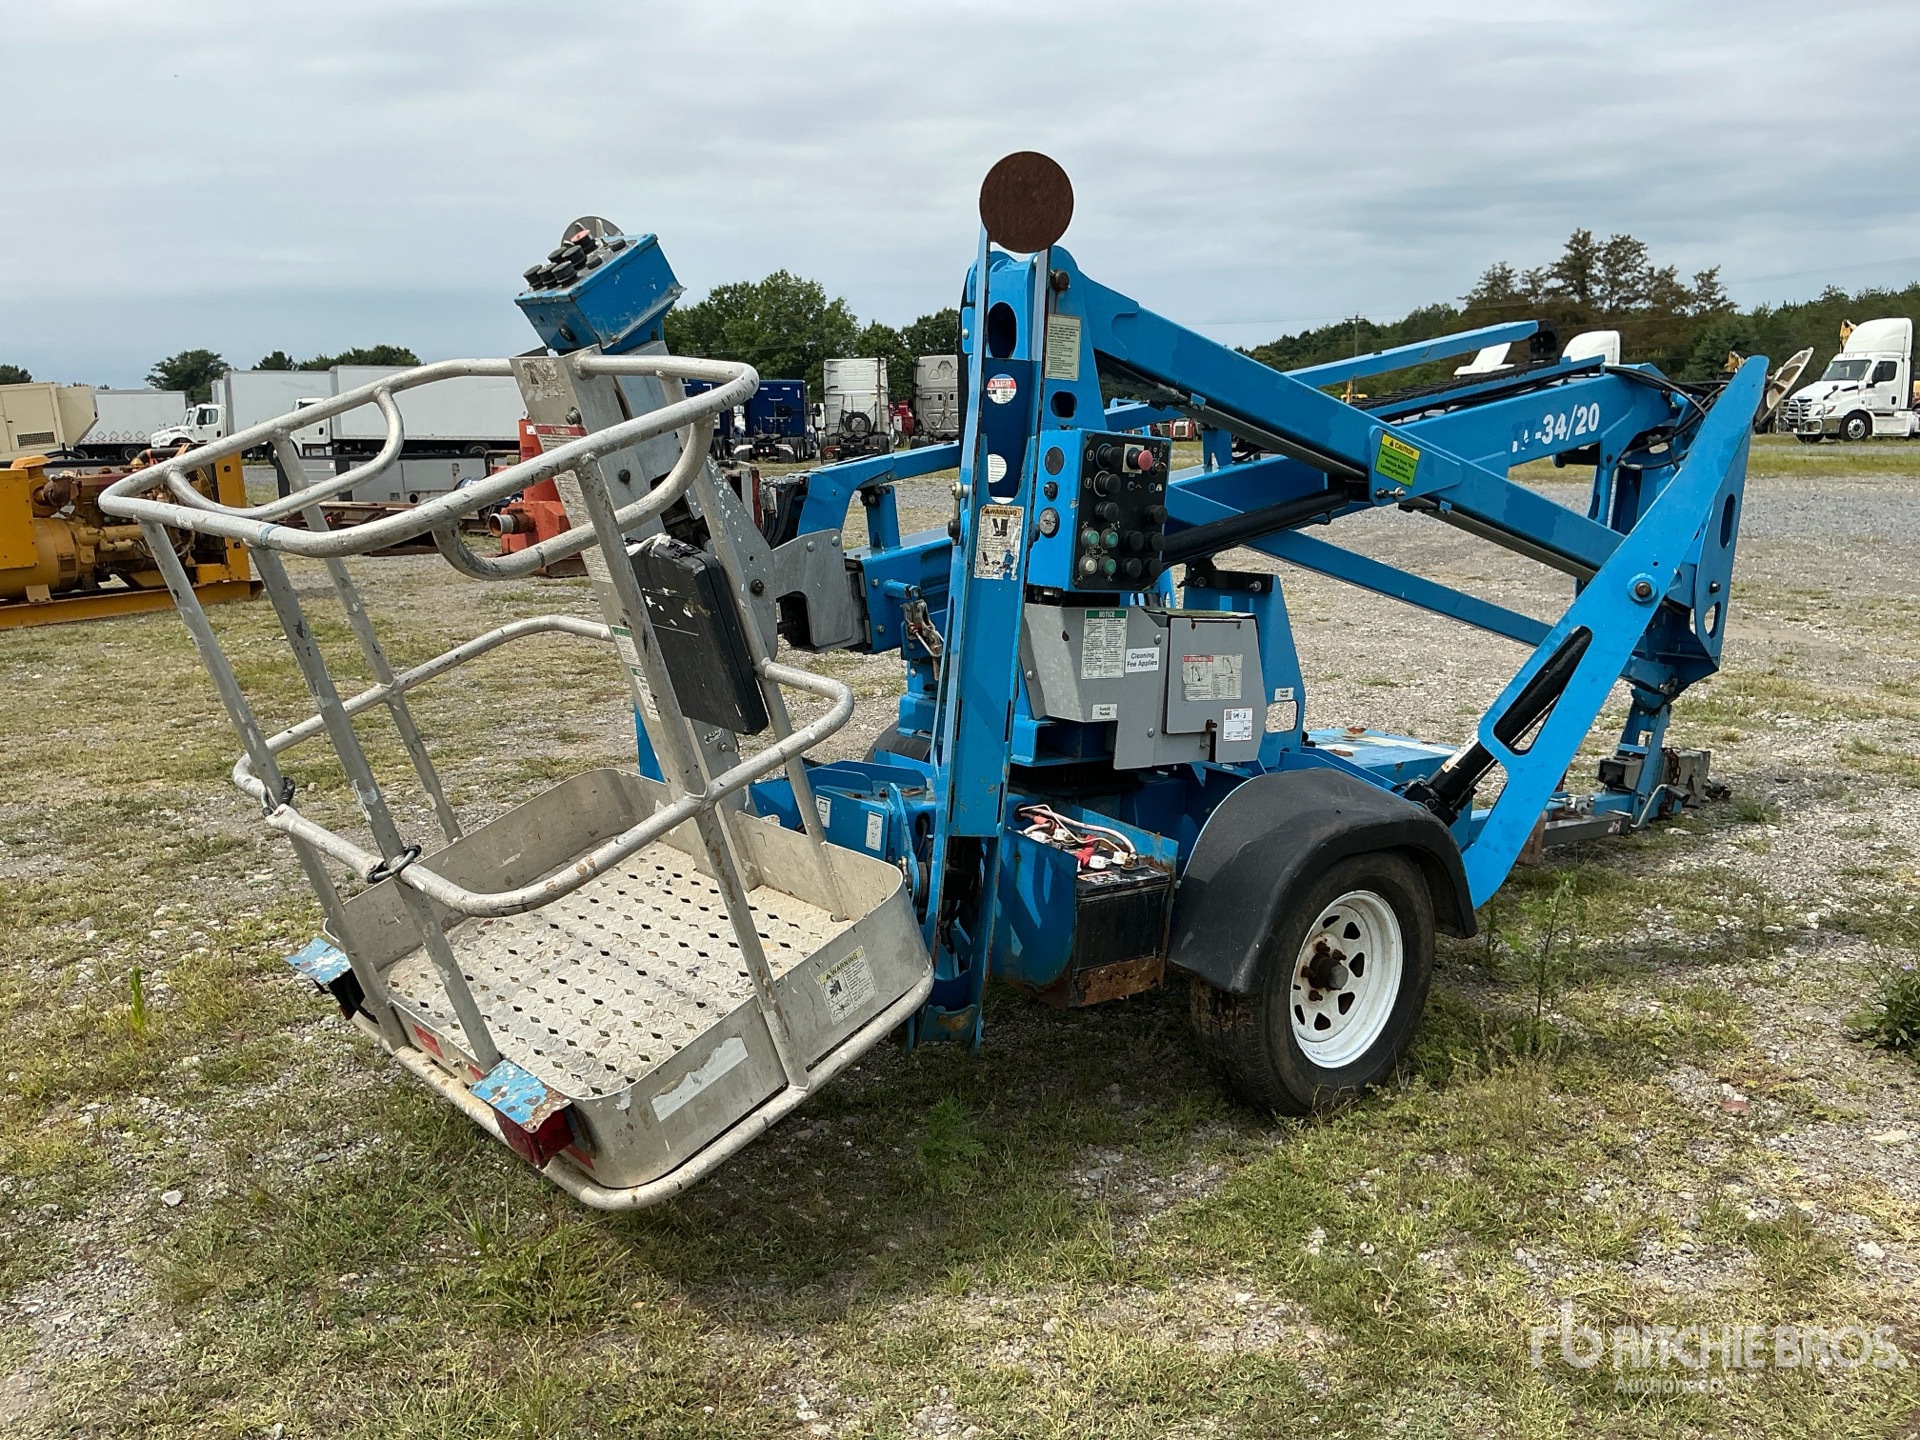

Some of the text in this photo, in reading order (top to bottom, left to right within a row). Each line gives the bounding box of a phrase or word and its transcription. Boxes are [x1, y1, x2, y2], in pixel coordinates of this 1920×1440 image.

[1394, 442, 1414, 456] CAUTION
[990, 508, 1018, 516] WARNING
[1098, 610, 1115, 618] NOTICE
[1137, 660, 1158, 668] Applies
[830, 952, 858, 976] WARNING
